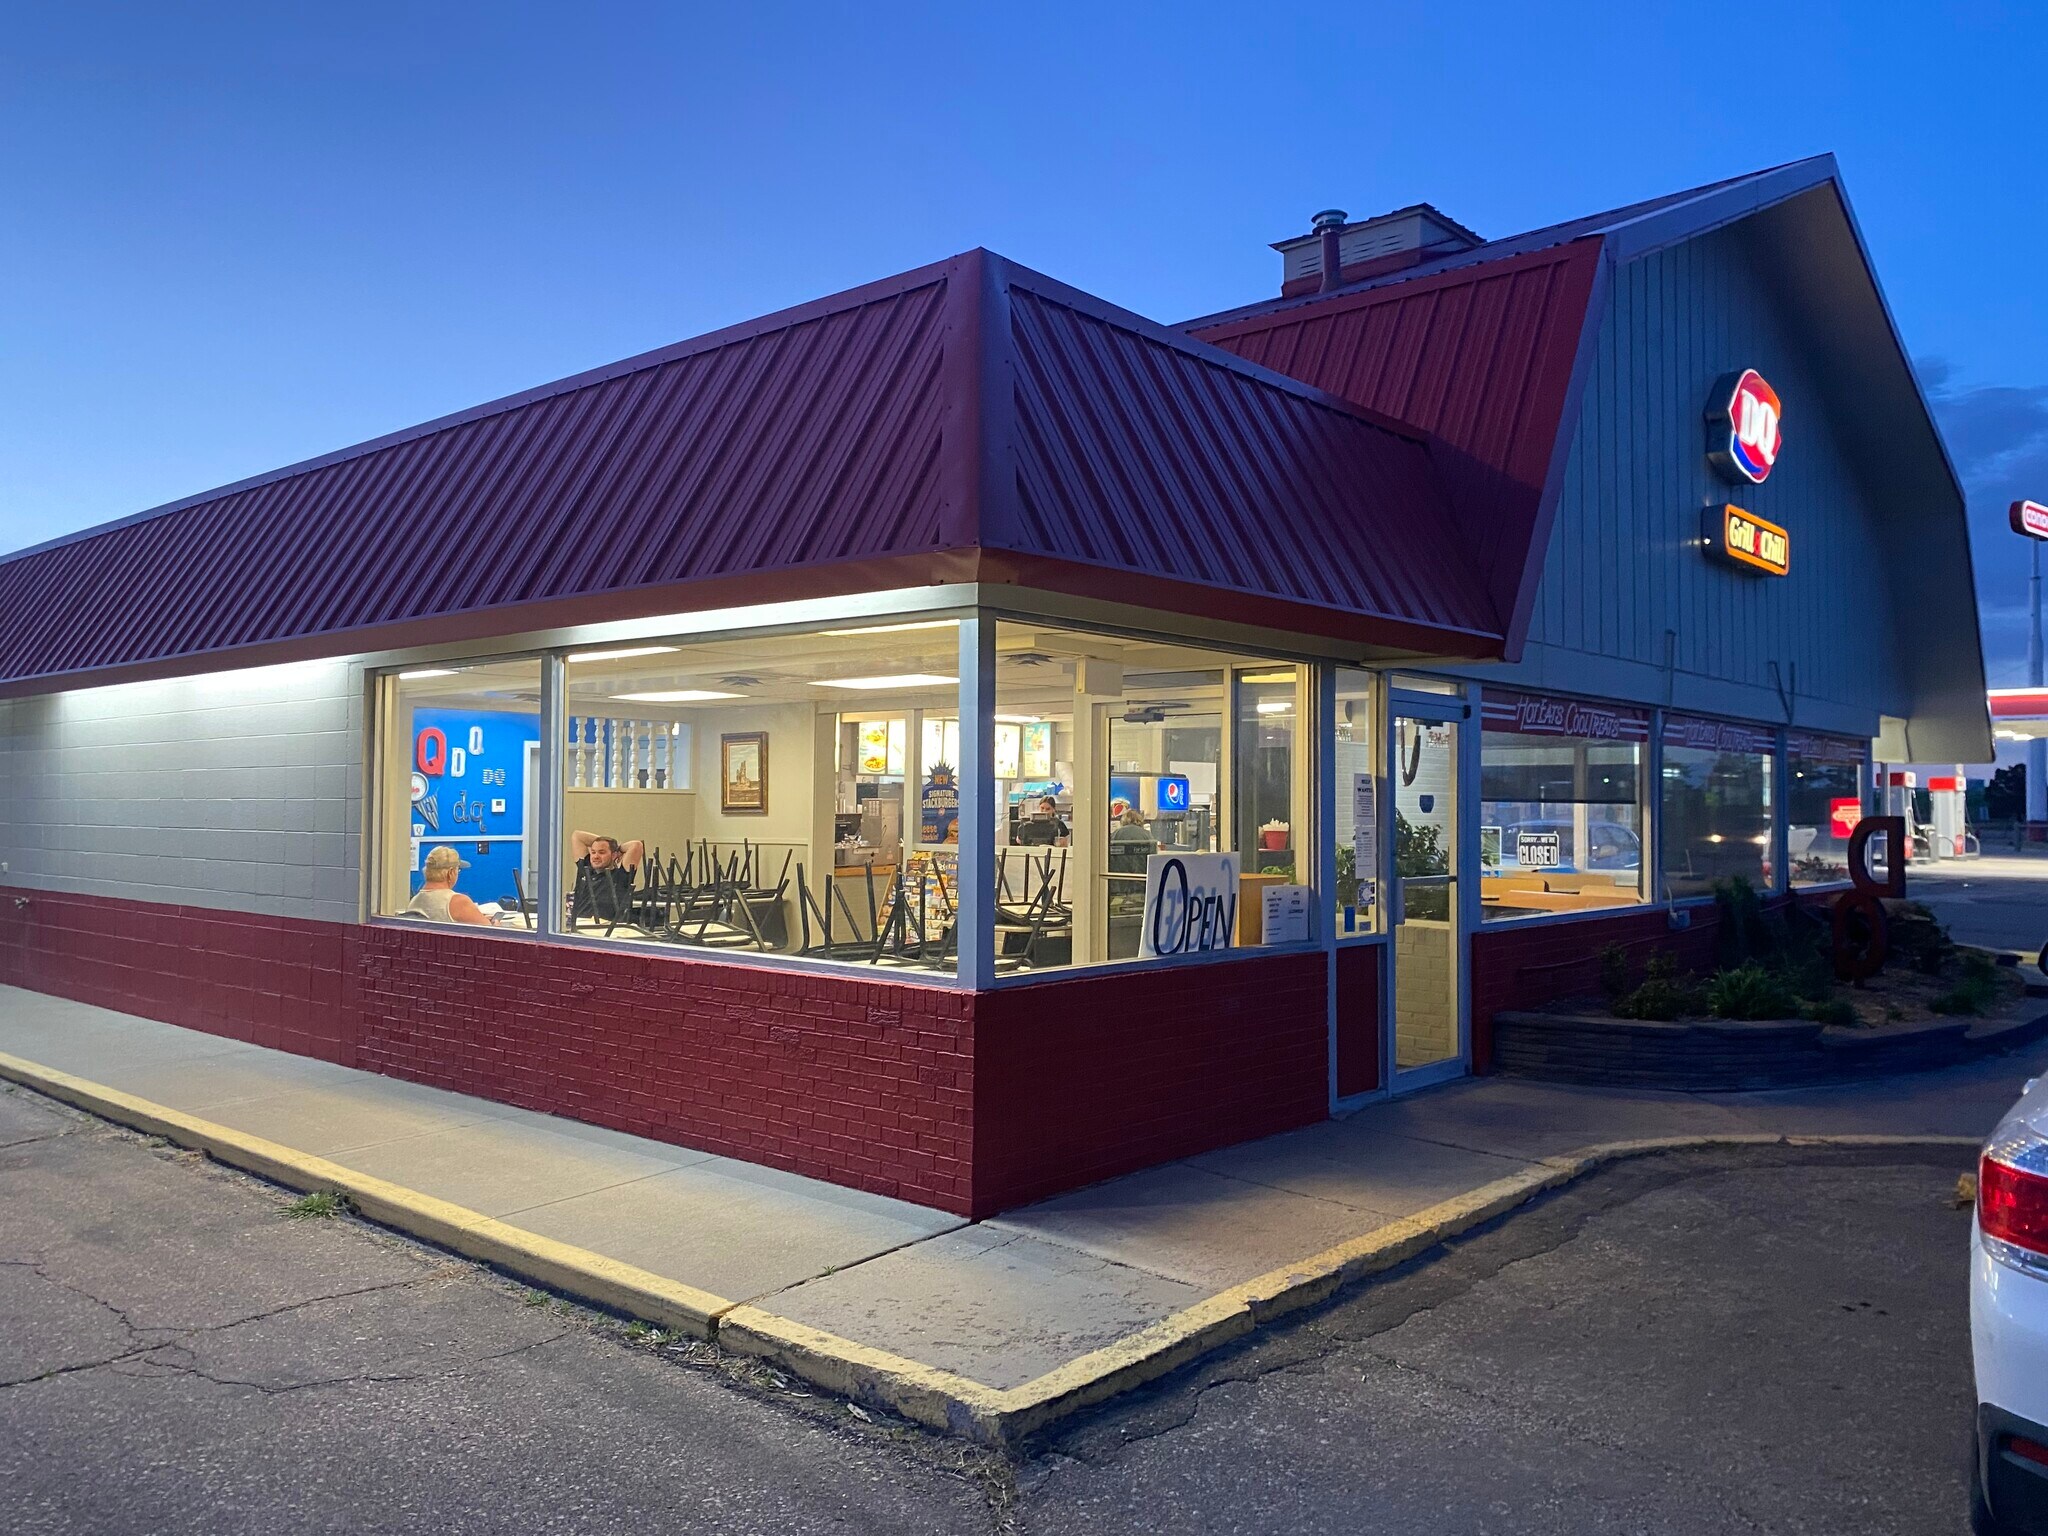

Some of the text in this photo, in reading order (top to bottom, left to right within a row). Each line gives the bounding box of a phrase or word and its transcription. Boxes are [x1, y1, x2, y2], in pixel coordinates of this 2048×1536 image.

[1740, 389, 1777, 465] DQ
[1729, 516, 1755, 553] Grill
[1761, 531, 1786, 566] Chill
[418, 727, 447, 775] Q
[1520, 845, 1557, 865] CLOSED
[1154, 858, 1236, 957] OPEN
